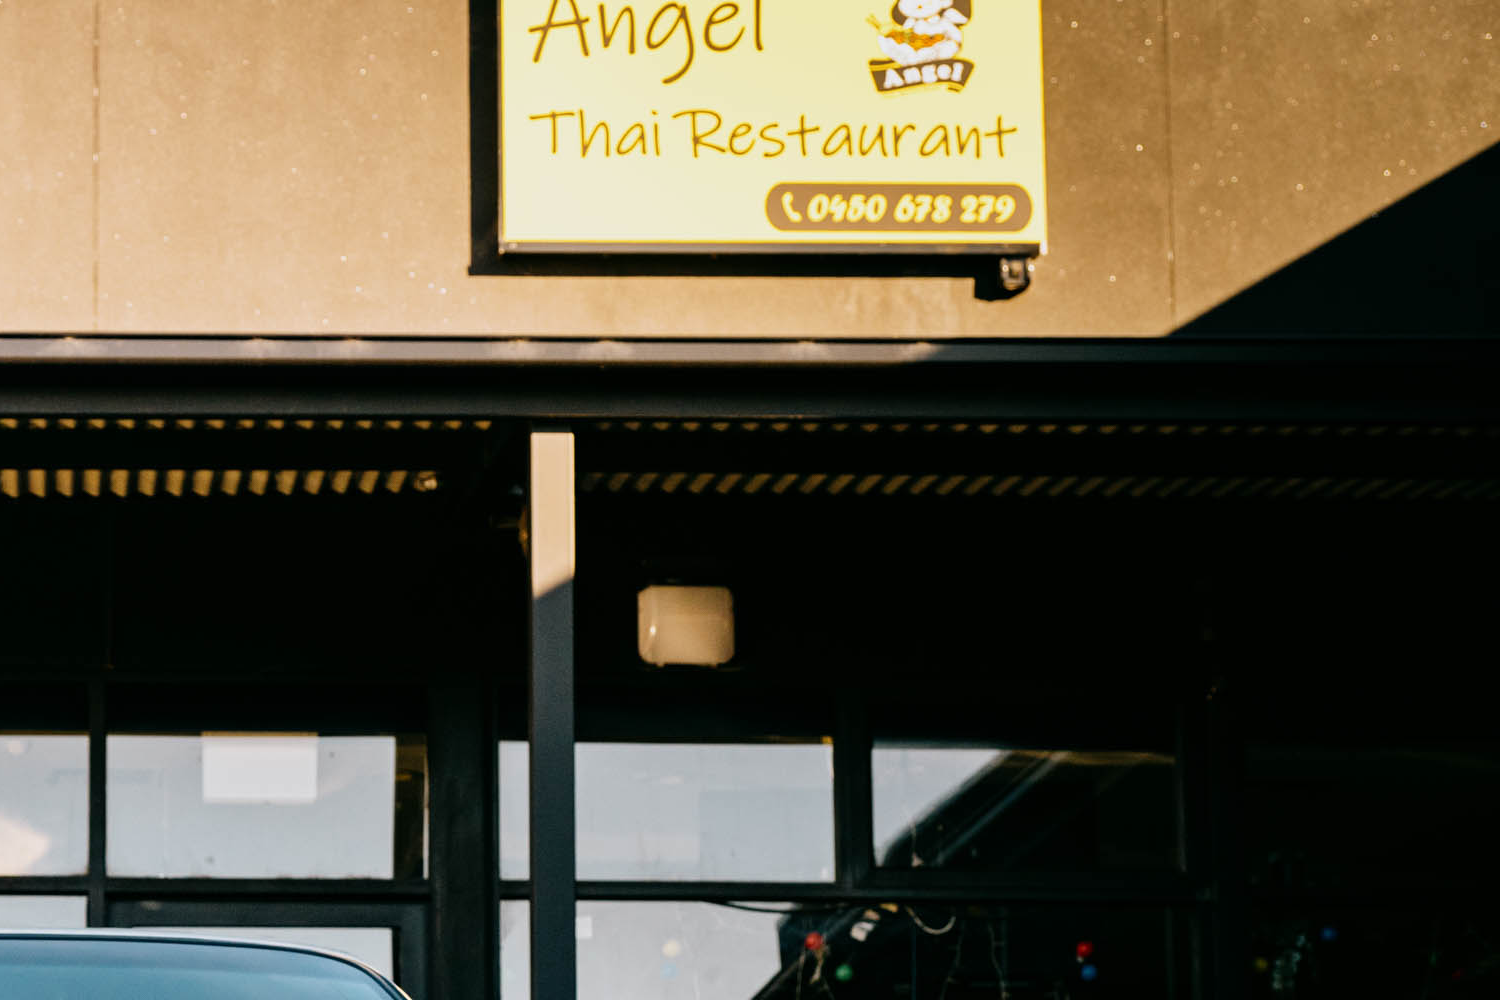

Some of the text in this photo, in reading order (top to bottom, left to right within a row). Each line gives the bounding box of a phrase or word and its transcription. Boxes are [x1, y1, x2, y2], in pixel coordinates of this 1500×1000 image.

[528, 0, 764, 84] Angel
[883, 62, 965, 89] Angel
[528, 108, 1019, 159] Thai Restaurant
[893, 193, 954, 223] 678
[960, 194, 1017, 223] 279
